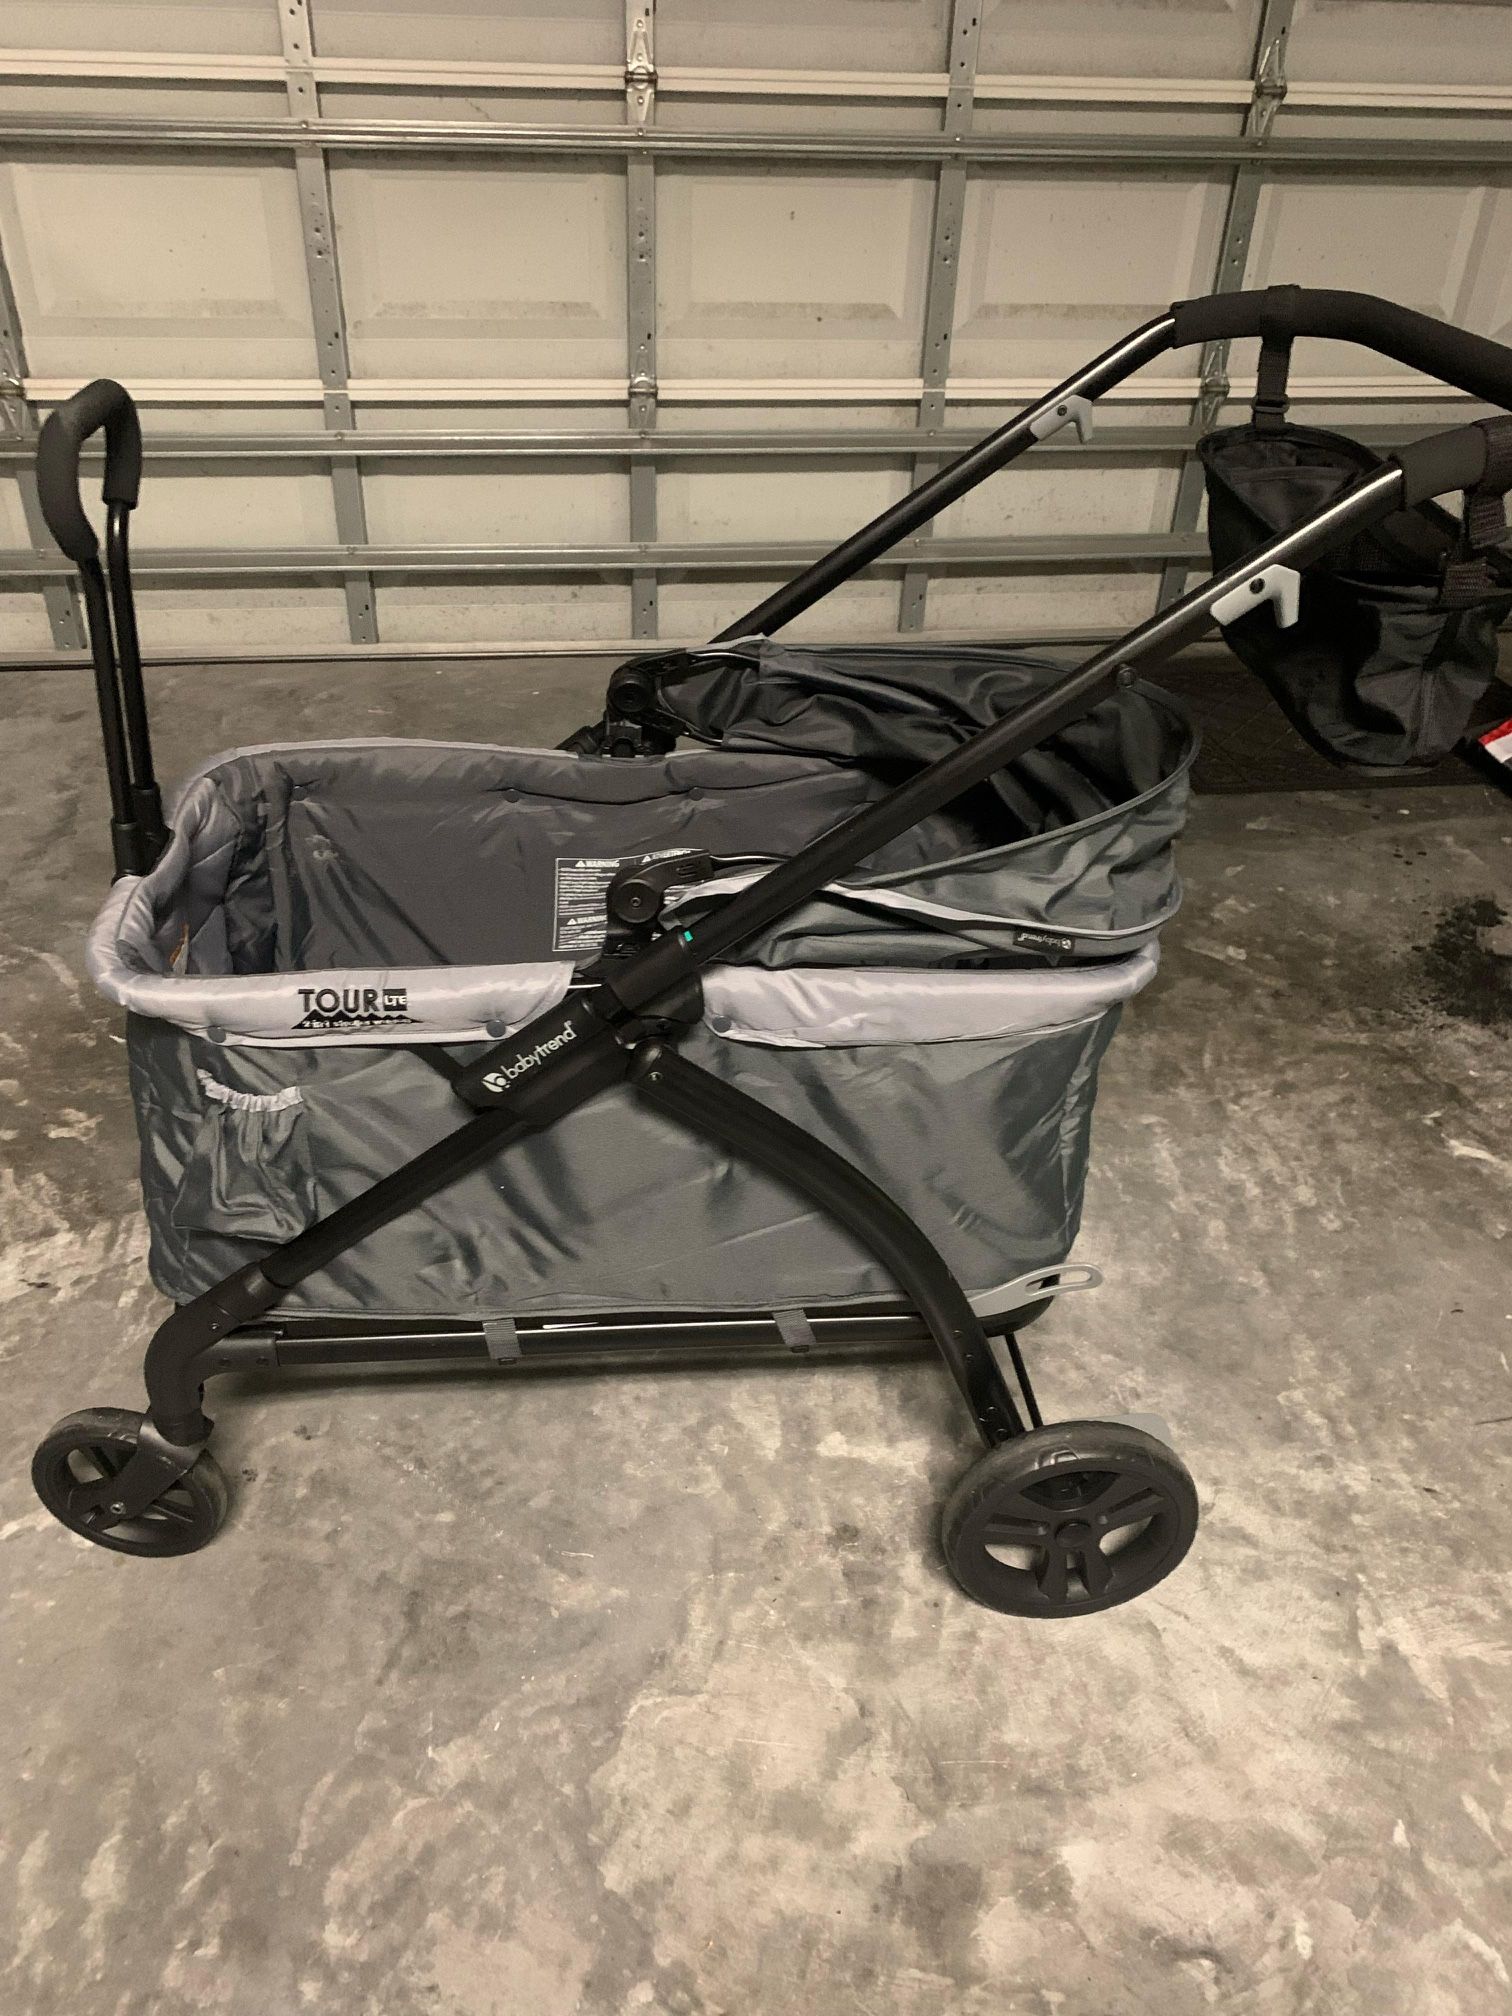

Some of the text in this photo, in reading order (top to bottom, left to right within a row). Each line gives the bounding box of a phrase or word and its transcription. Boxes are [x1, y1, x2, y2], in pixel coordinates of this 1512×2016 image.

[298, 988, 407, 1013] TOUR LTE
[501, 1021, 577, 1079] babytrend
